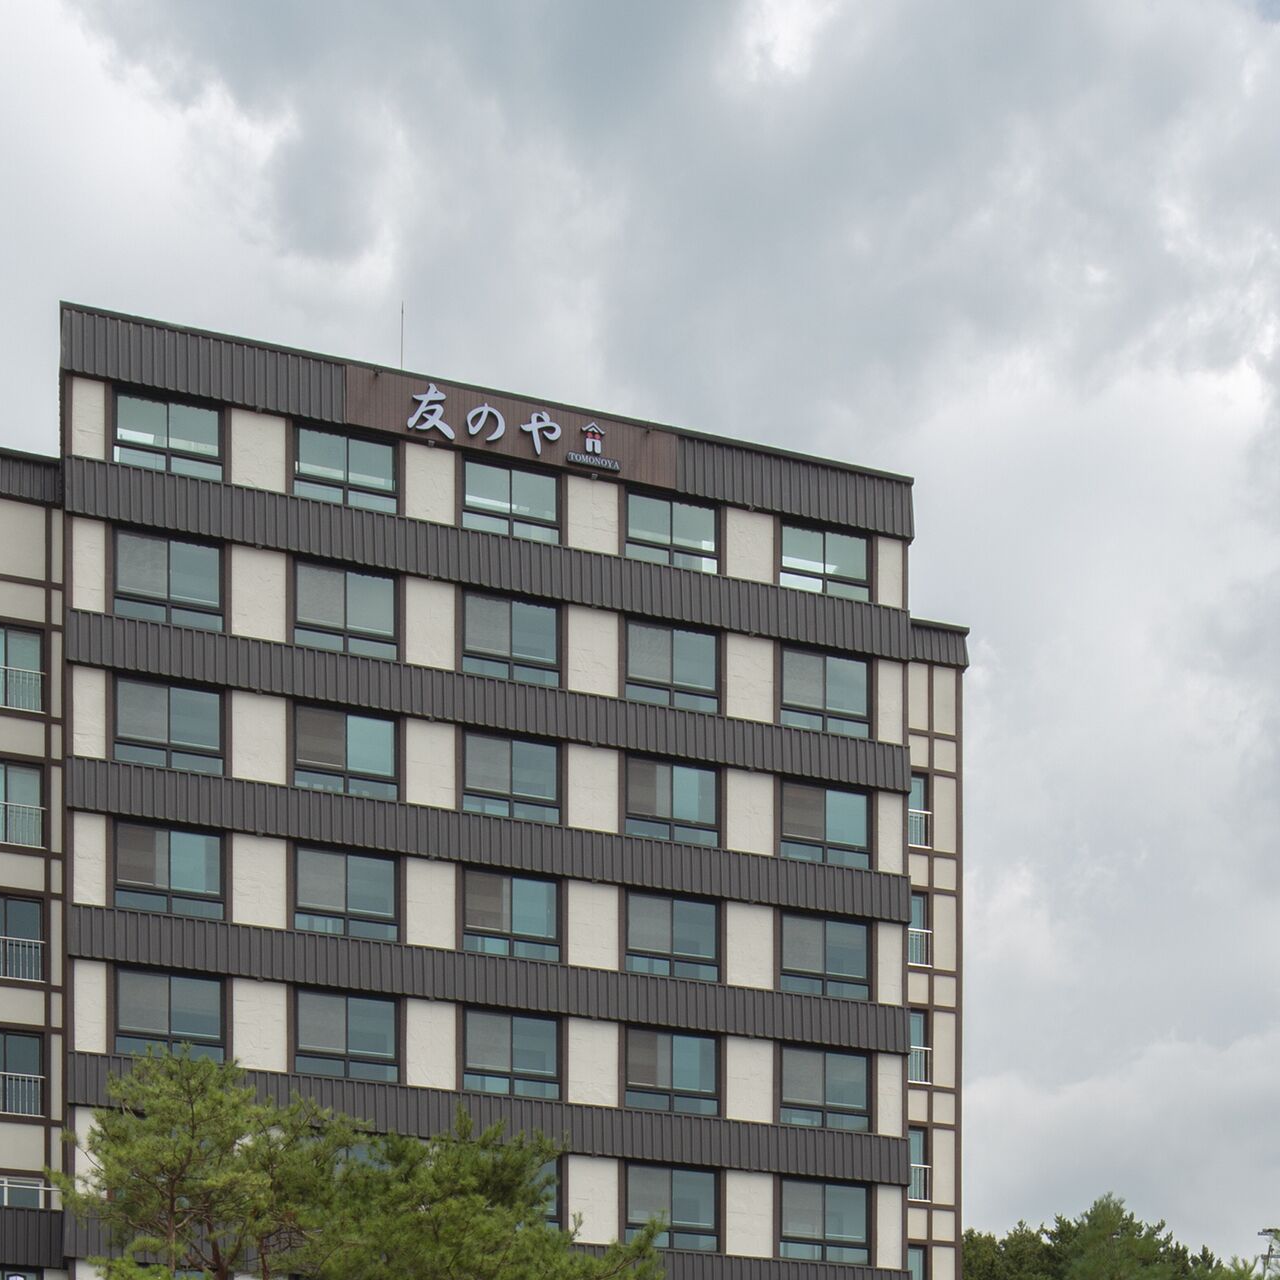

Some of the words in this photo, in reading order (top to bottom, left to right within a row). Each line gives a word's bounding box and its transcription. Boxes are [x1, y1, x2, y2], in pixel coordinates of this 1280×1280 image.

[407, 382, 562, 456] 友のや
[568, 451, 620, 470] TOMONOYA
